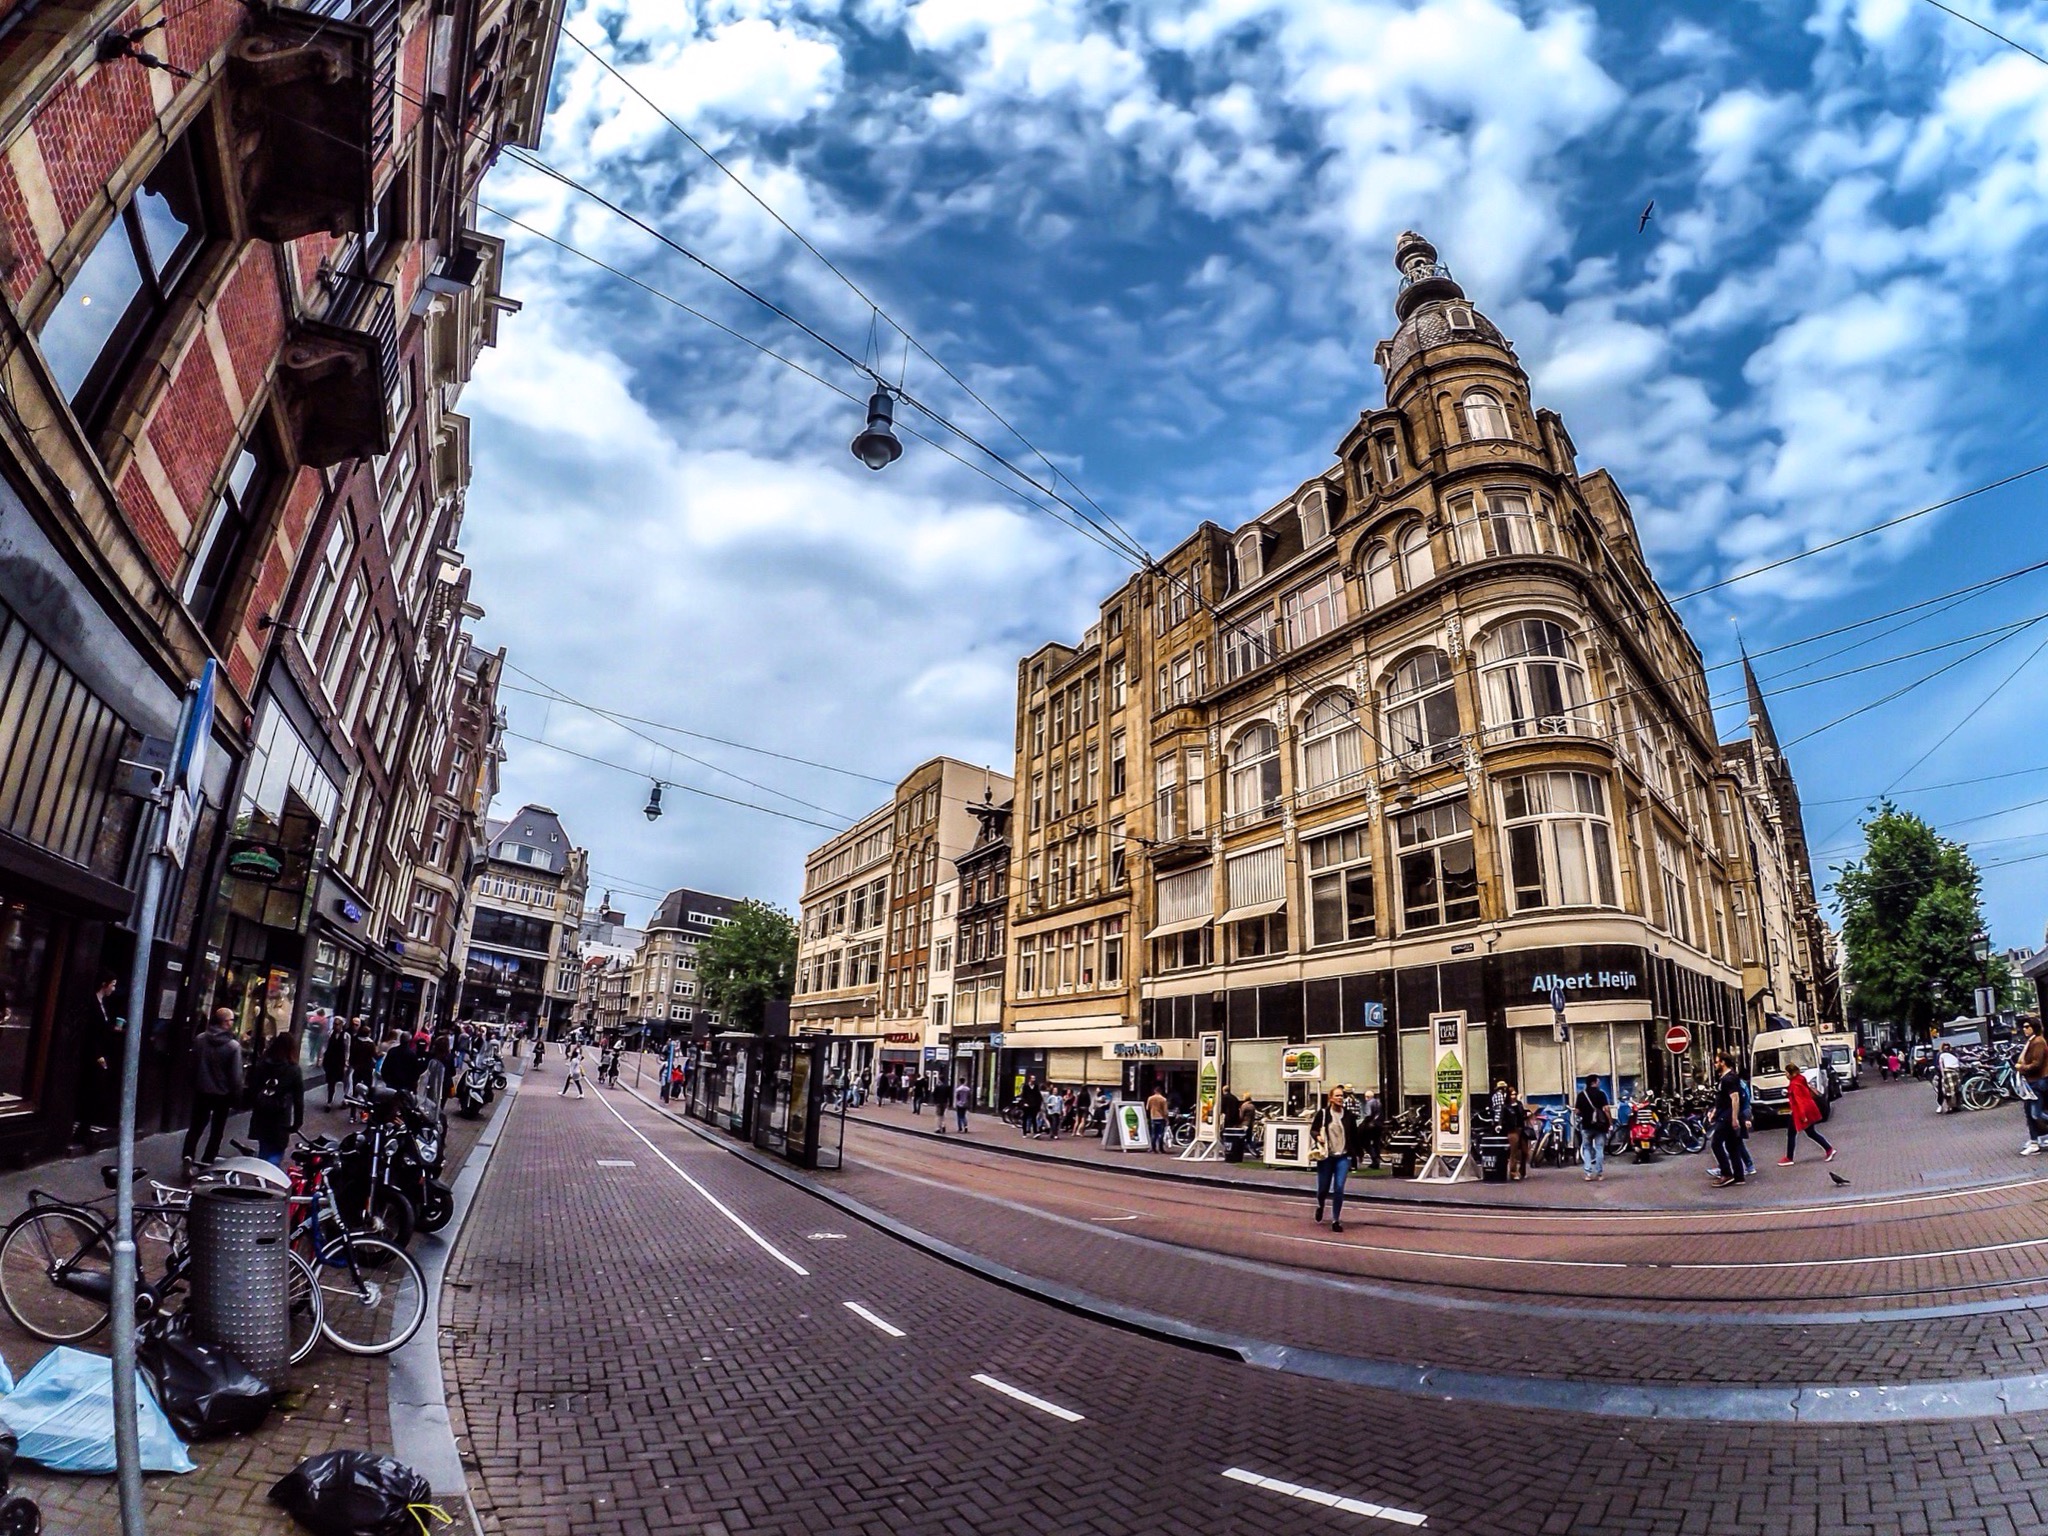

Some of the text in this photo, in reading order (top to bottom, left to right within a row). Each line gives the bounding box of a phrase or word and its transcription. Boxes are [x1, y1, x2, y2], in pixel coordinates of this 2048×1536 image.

[1532, 971, 1637, 992] Albert Heijn
[1277, 1133, 1298, 1143] PURE
